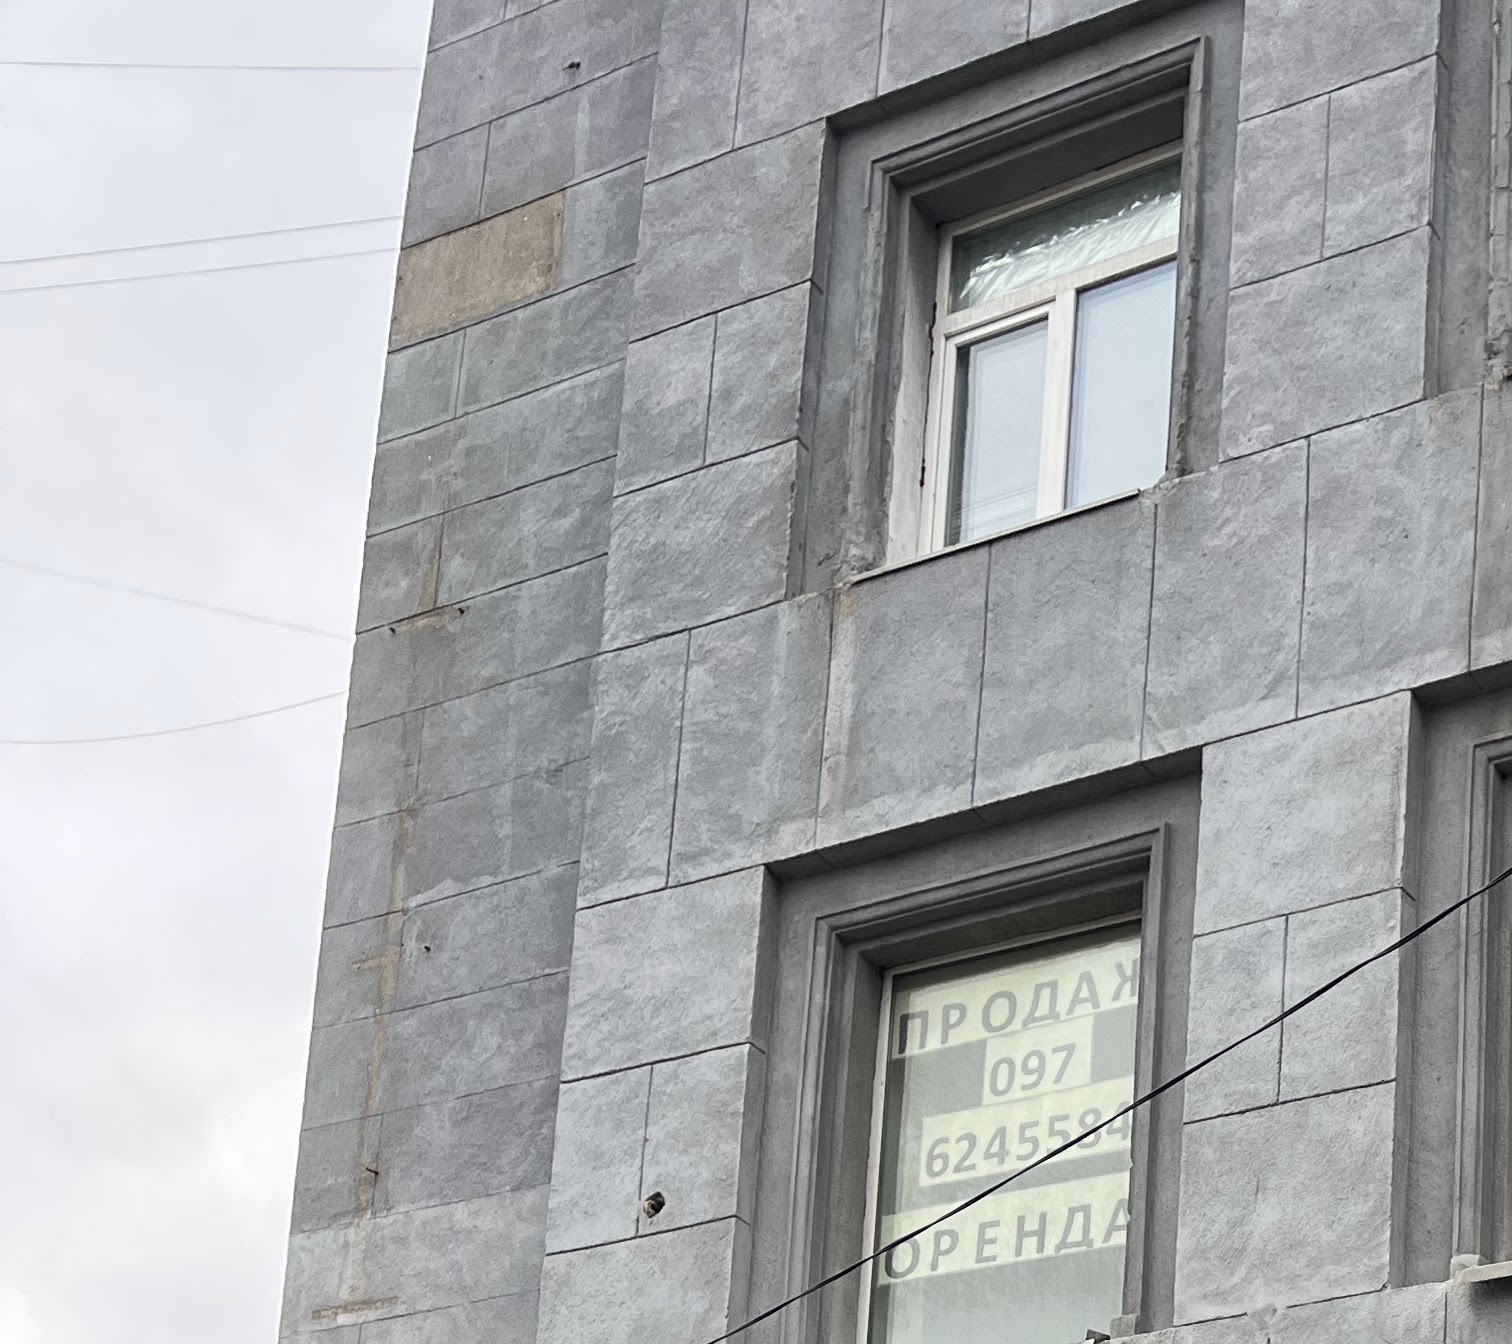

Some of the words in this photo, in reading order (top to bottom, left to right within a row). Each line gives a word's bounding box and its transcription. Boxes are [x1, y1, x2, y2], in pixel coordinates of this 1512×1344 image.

[989, 1042, 1077, 1097] 097
[925, 1100, 1131, 1178] 6245584
[884, 1197, 1128, 1280] ОРЕНДА
